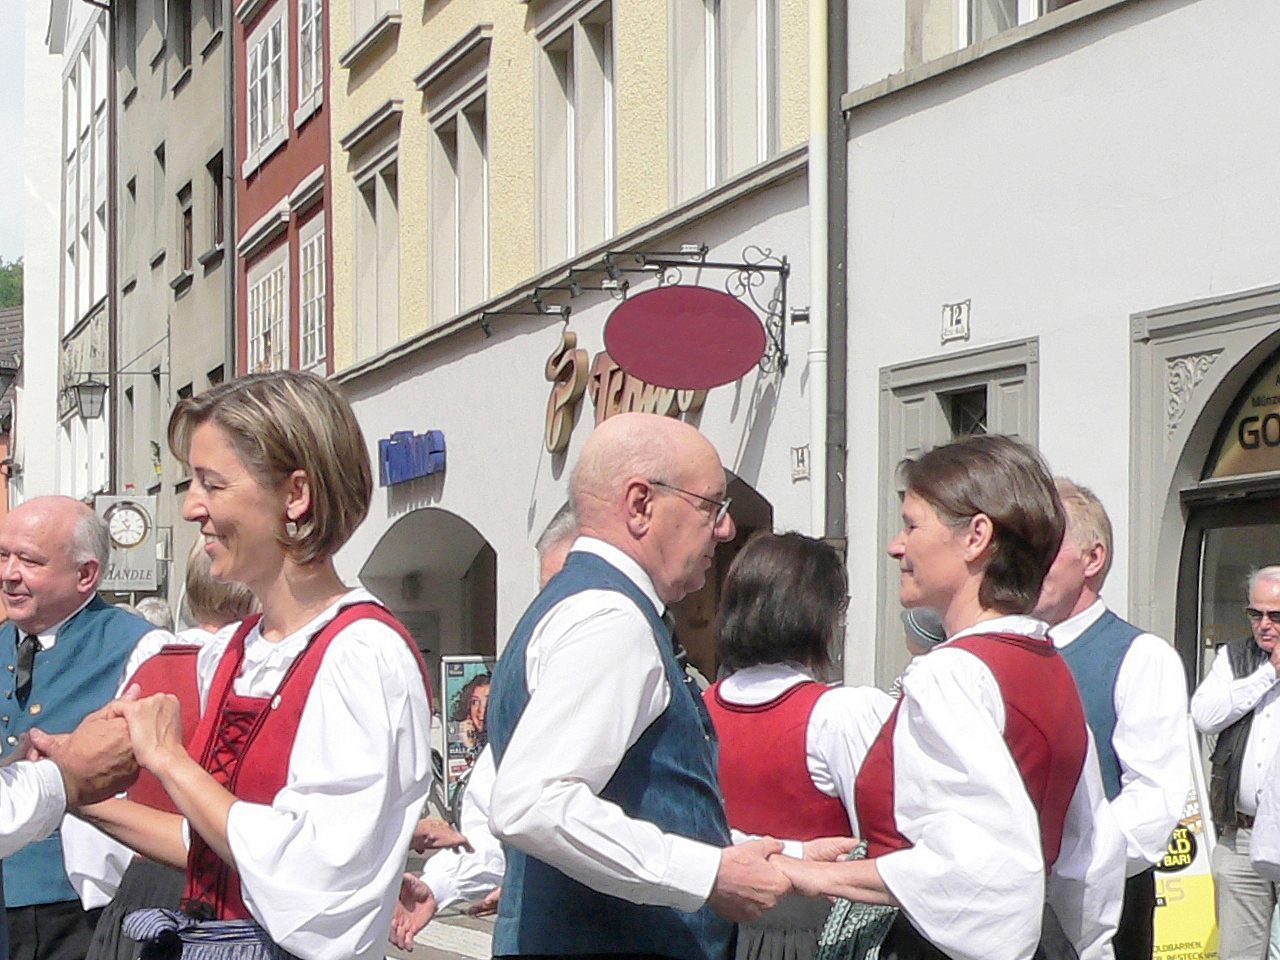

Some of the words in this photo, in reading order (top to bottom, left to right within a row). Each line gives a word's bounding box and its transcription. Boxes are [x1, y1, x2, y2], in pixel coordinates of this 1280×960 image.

[949, 305, 962, 327] 12
[1173, 828, 1188, 840] RT
[1168, 839, 1191, 855] LD
